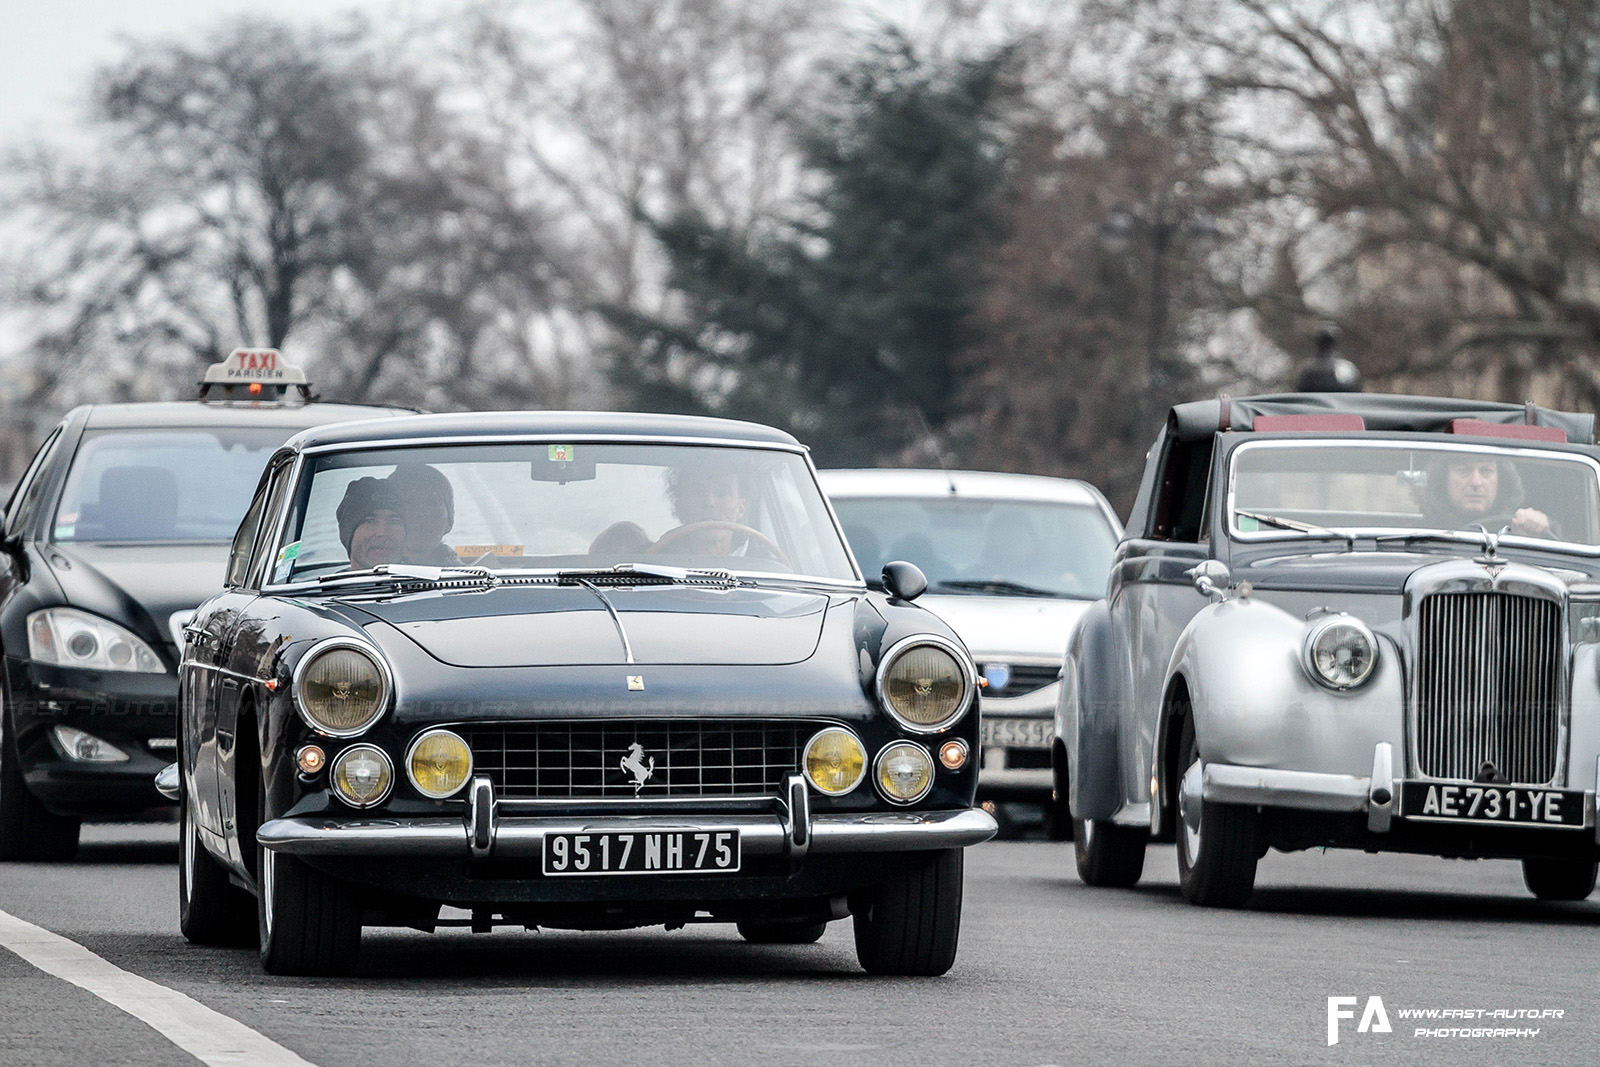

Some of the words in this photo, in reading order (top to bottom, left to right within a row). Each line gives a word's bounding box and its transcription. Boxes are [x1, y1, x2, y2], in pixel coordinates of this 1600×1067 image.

[238, 352, 276, 370] TAXI
[228, 369, 283, 378] PARISIEN
[556, 452, 566, 460] 12
[1422, 785, 1564, 822] AE-731-YE
[553, 835, 634, 870] 9517
[645, 833, 683, 869] NH
[694, 833, 732, 868] 75
